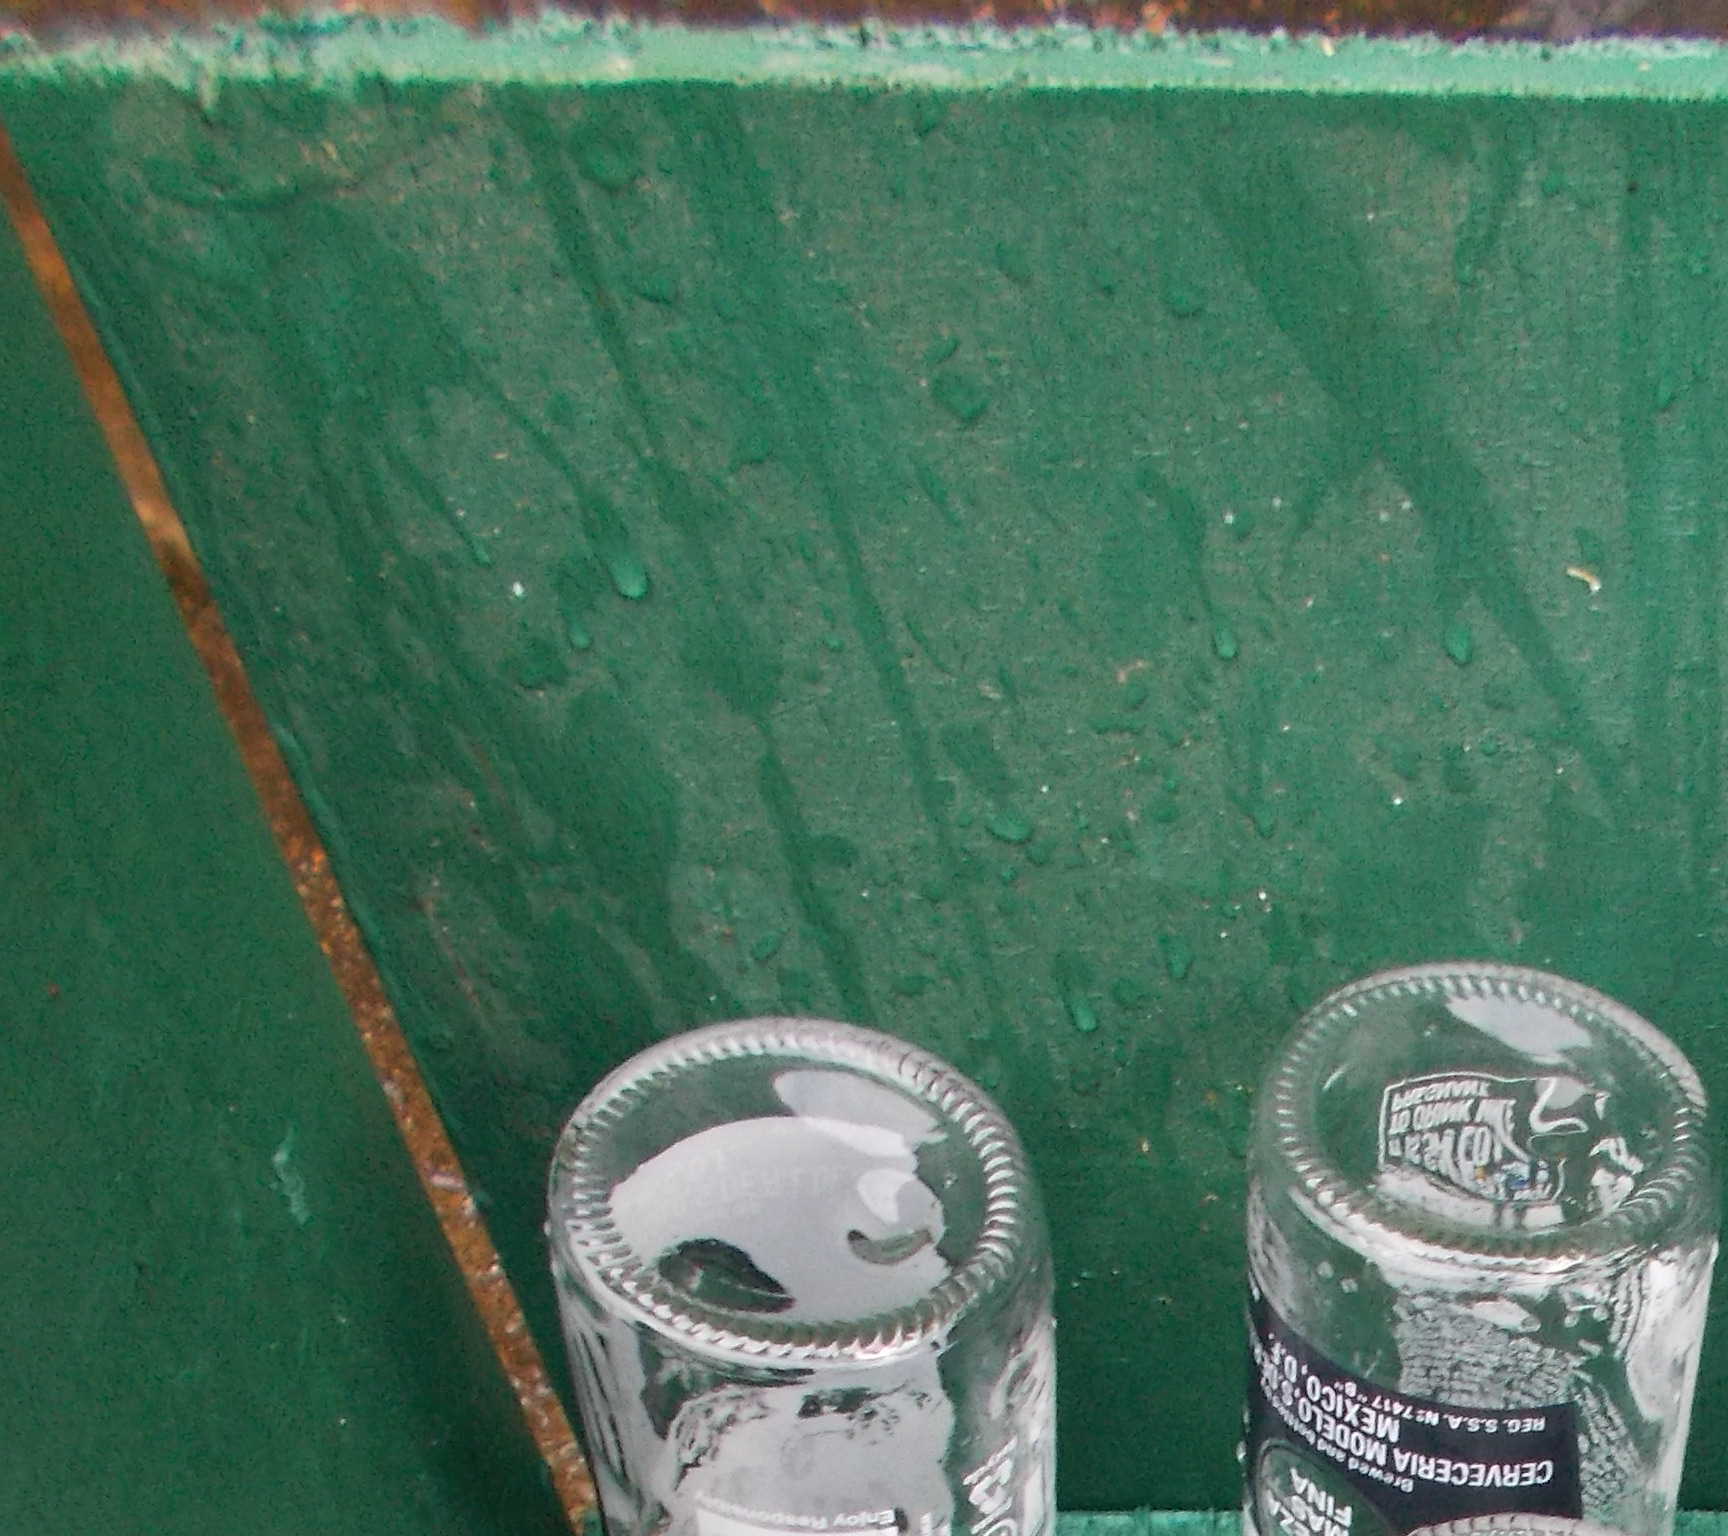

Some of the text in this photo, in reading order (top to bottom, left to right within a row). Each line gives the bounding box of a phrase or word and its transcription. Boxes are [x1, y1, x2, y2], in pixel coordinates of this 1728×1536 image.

[1372, 1394, 1413, 1421] 7417
[1504, 1416, 1545, 1431] REG.
[1348, 1458, 1414, 1493] Brewed
[1393, 1448, 1553, 1488] CERVECERIA
[1290, 1468, 1352, 1527] FINA
